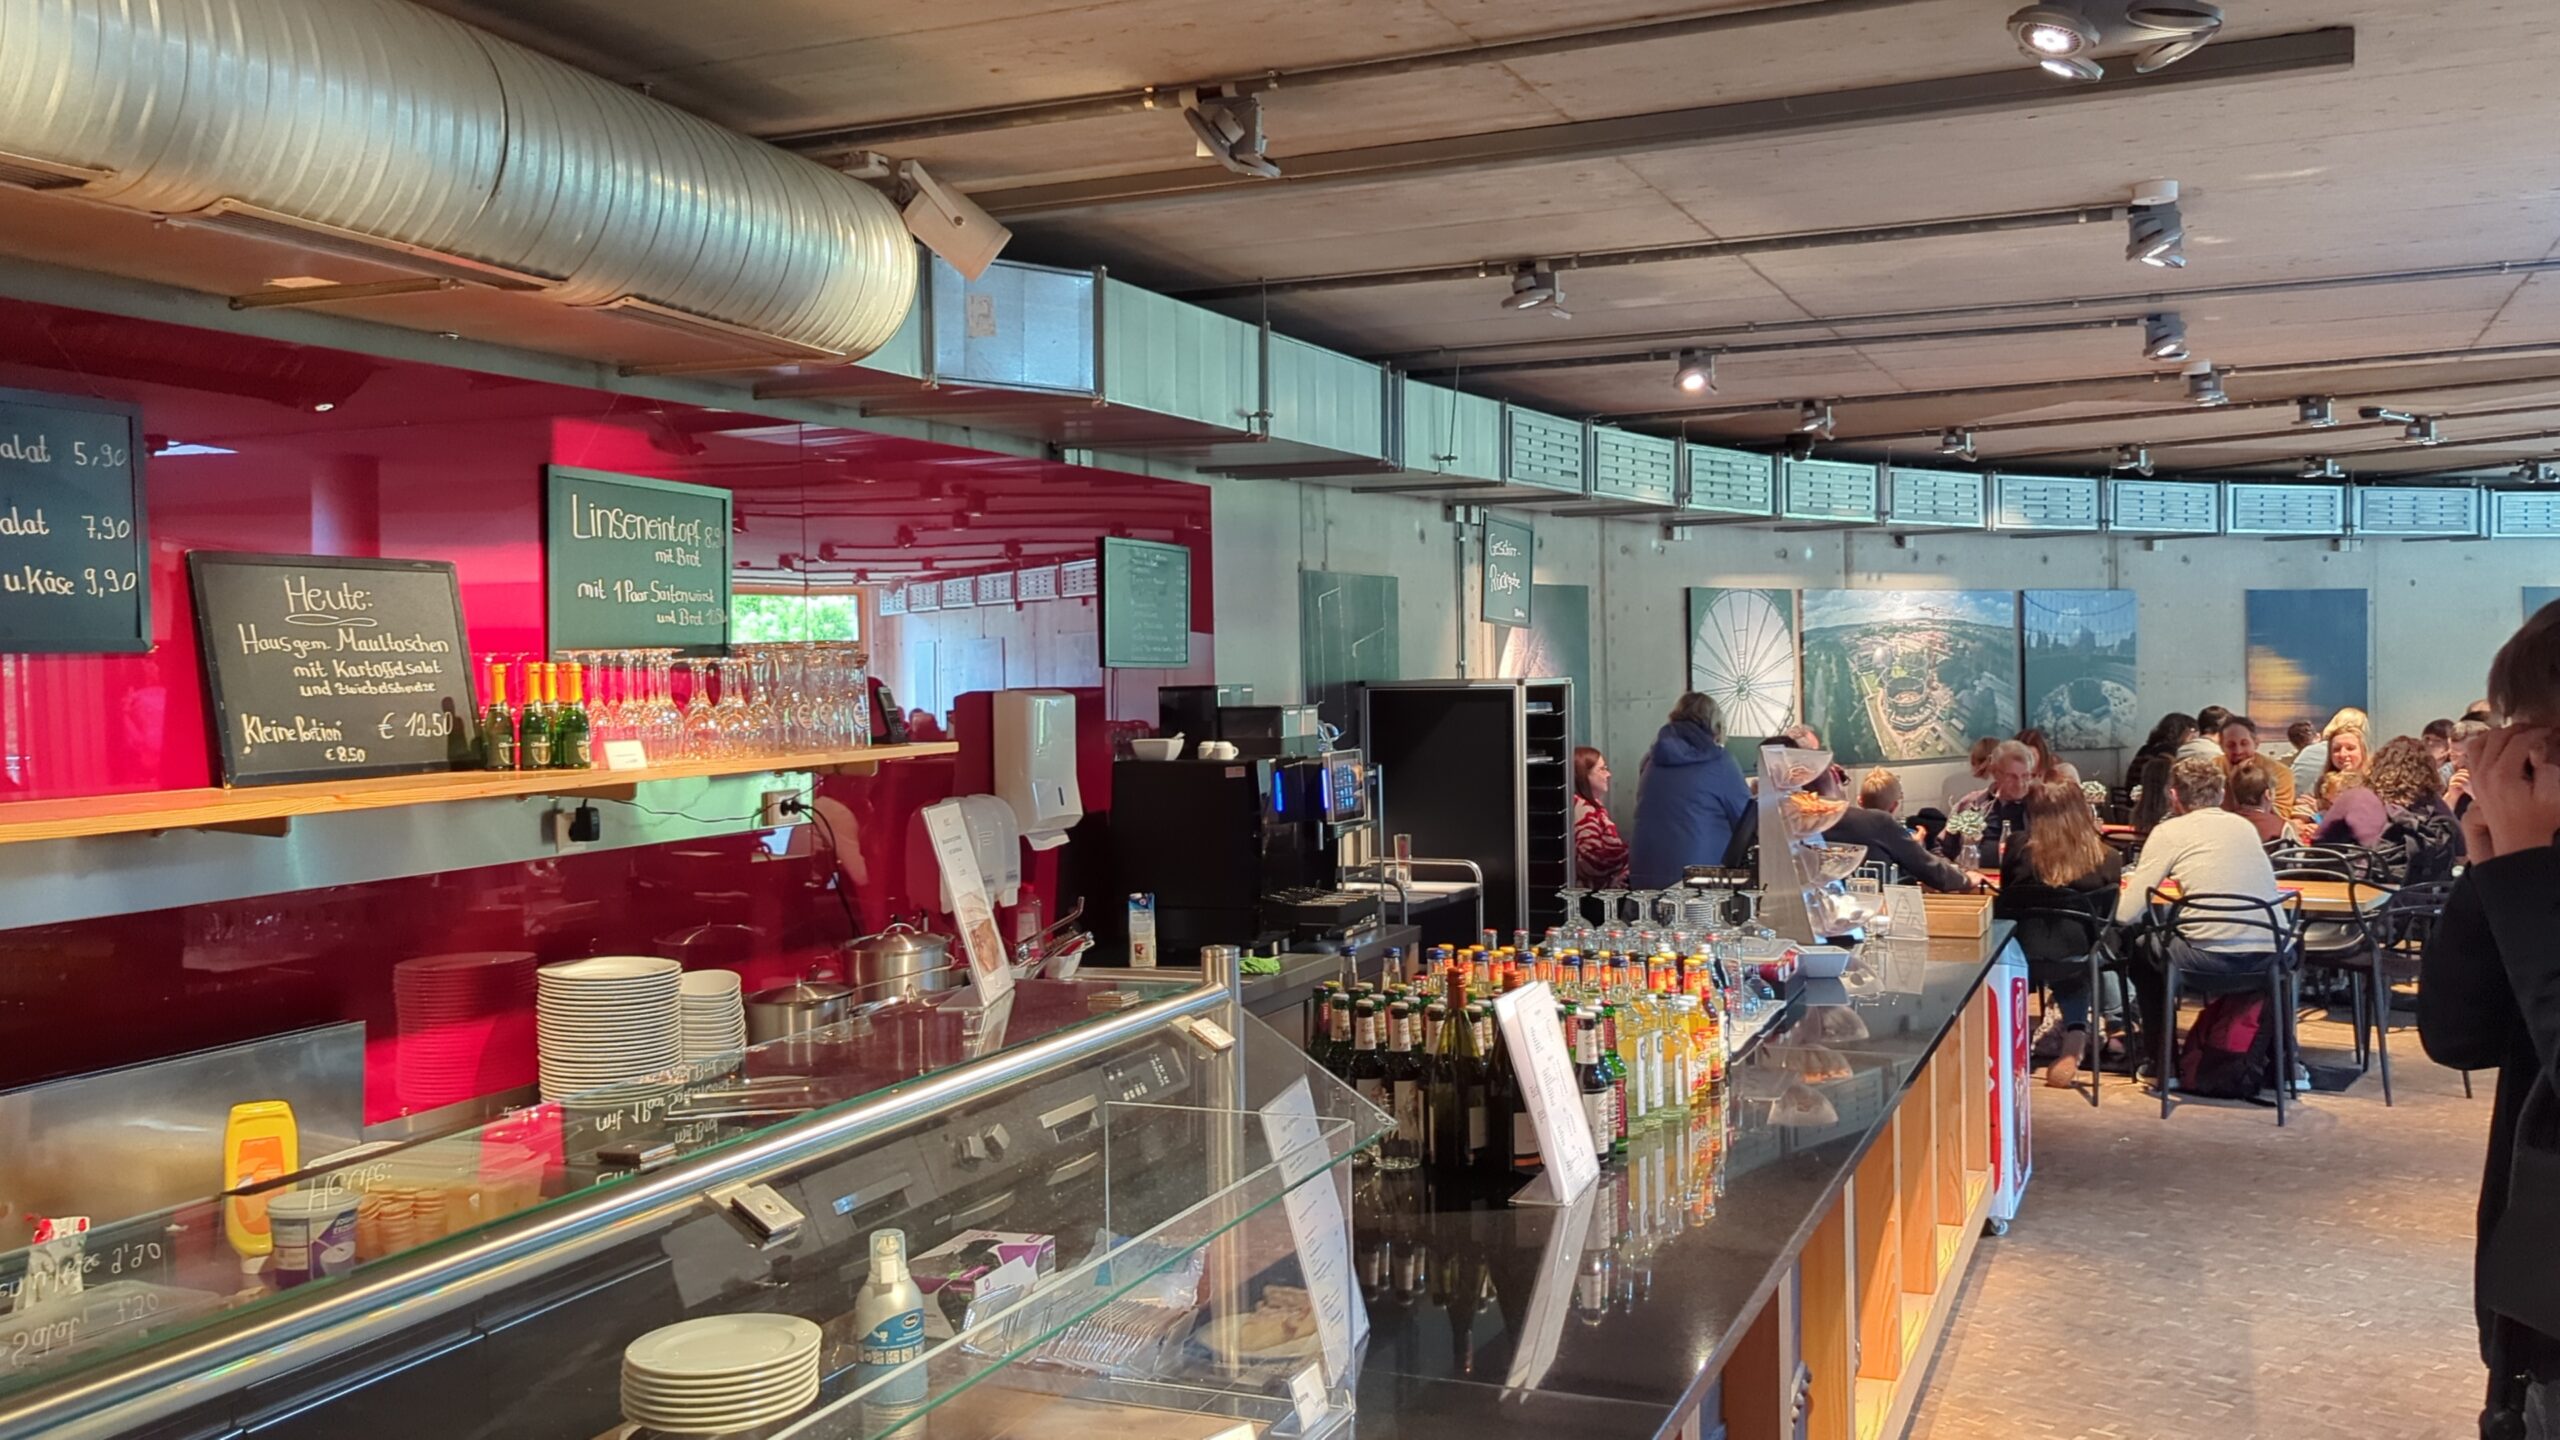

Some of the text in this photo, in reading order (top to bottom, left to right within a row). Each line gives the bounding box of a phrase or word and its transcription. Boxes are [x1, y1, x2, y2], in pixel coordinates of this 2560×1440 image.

[74, 441, 128, 468] 5,90
[81, 515, 131, 540] 7,90
[572, 494, 702, 547] Linseneintopf
[655, 547, 702, 567] mit Brot
[84, 568, 137, 598] 9,90
[284, 575, 374, 613] Heute:
[577, 579, 607, 599] mit
[656, 610, 677, 624] und
[678, 608, 704, 625] Brot
[336, 627, 450, 653] Maultaschen
[293, 659, 443, 679] mit Kartoffelsalat
[299, 680, 333, 697] und
